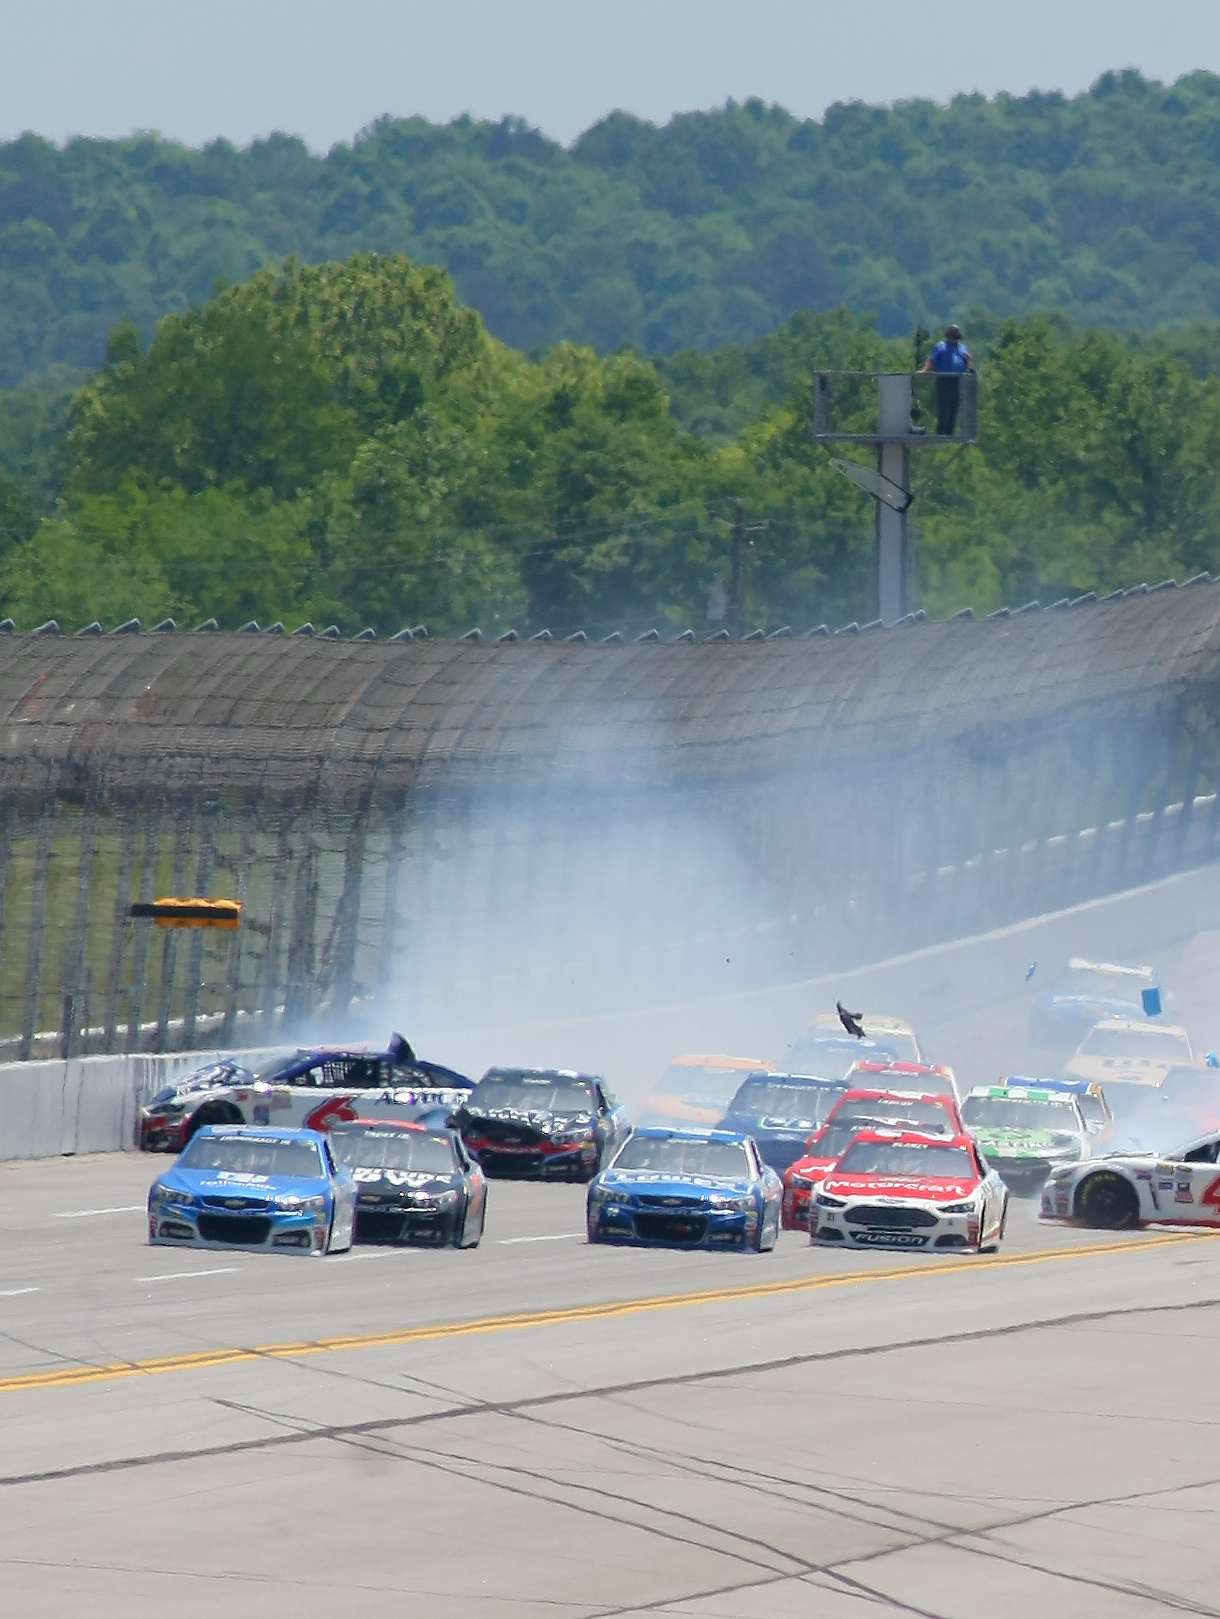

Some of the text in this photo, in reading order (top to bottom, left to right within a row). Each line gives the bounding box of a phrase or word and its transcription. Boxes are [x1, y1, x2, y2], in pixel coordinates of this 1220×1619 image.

[304, 1095, 360, 1131] 6
[825, 1181, 966, 1196] Motorcraft
[855, 1233, 924, 1246] FUSION
